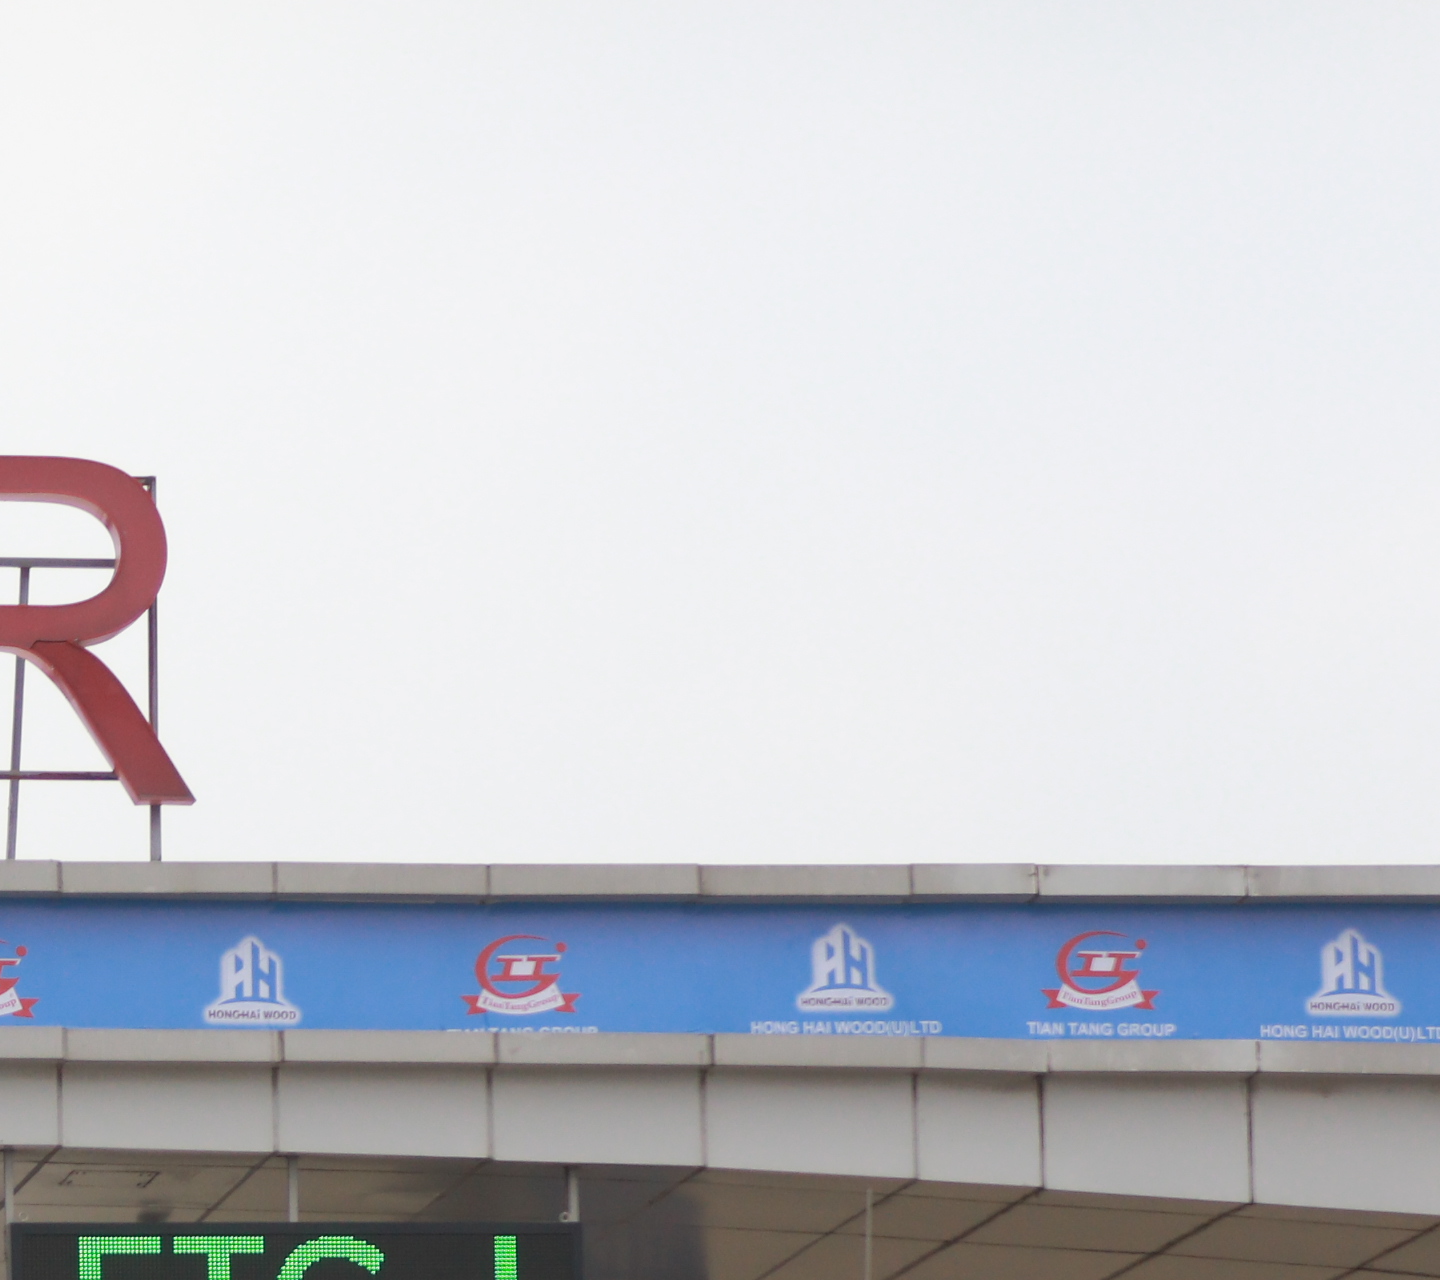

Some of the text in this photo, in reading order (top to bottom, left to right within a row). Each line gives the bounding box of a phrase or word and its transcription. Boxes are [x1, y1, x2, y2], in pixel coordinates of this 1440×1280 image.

[1363, 1001, 1395, 1011] WOOD
[263, 1010, 296, 1020] WOOD
[750, 1021, 800, 1035] HONG
[804, 1021, 830, 1035] HAI
[1026, 1022, 1176, 1037] TIAN TANG GROUP
[1260, 1024, 1310, 1038] HONG
[1312, 1025, 1339, 1038] HAI
